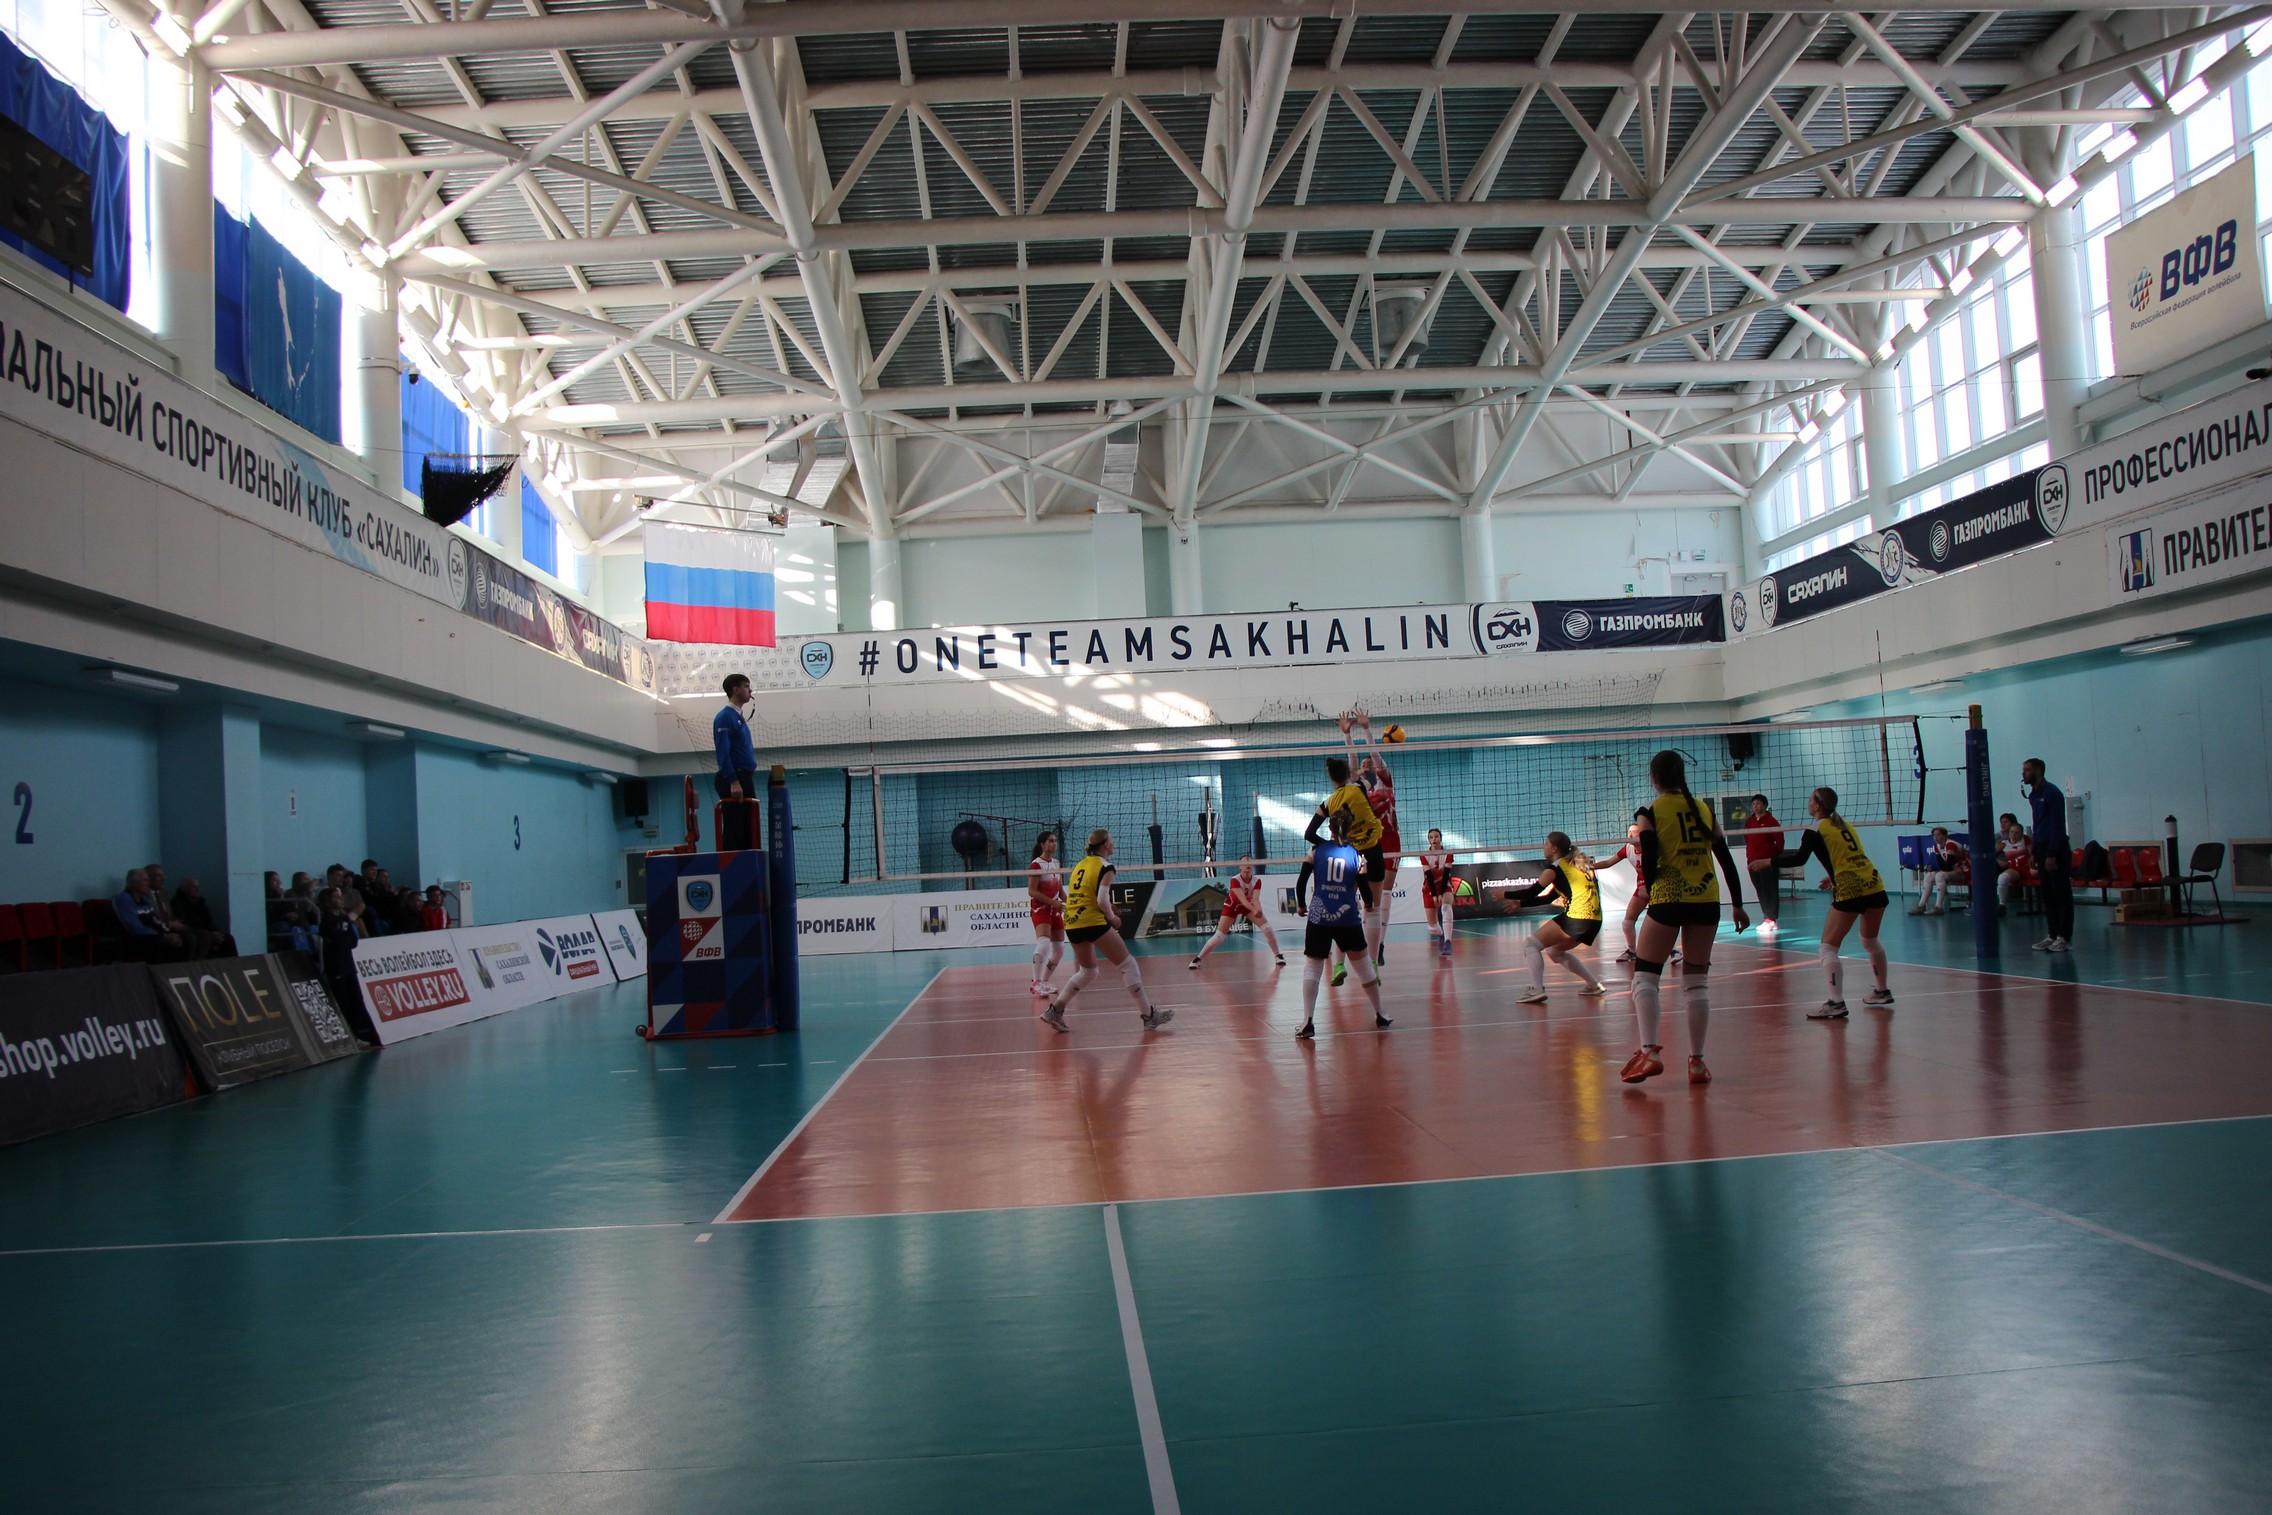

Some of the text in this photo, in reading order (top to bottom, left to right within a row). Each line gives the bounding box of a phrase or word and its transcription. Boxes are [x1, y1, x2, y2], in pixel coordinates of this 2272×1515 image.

[2160, 219, 2237, 302] ВФВ
[2130, 271, 2242, 331] Всероссийская федерация волейбола
[0, 320, 440, 578] АЛЬНЫЙ СПОРТИВНЫЙ КЛУБ «САХАЛИН»
[1954, 499, 2030, 545] ГАЗПРОМБАНК
[2163, 503, 2272, 576] ПРАВИТЕ
[490, 581, 534, 622] ГАЗПРОМБАНК
[1788, 566, 1848, 604] САХАЛИН
[1600, 611, 1704, 632] ГАЗПРОМБАНК
[859, 612, 1449, 676] #ONETEAMSAKHALIN
[1980, 762, 1991, 797] JINLING
[13, 781, 34, 844] 2
[1676, 811, 1703, 843] 12
[512, 814, 521, 851] 3
[1841, 830, 1859, 852] 9
[1073, 869, 1085, 890] 3
[1327, 857, 1346, 882] 10
[954, 900, 1029, 912] ПРАВИТЕЛЬСТ
[1111, 888, 1136, 905] LE
[970, 910, 1032, 921] САХАЛИНС
[970, 921, 1020, 931] ОБЛАСТИ
[356, 948, 454, 978] ВЕСЬ ВОЛЕЙБОЛ ЗДЕСЬ
[696, 946, 722, 958] ВФВ
[389, 976, 465, 1013] VOLLEY.RU
